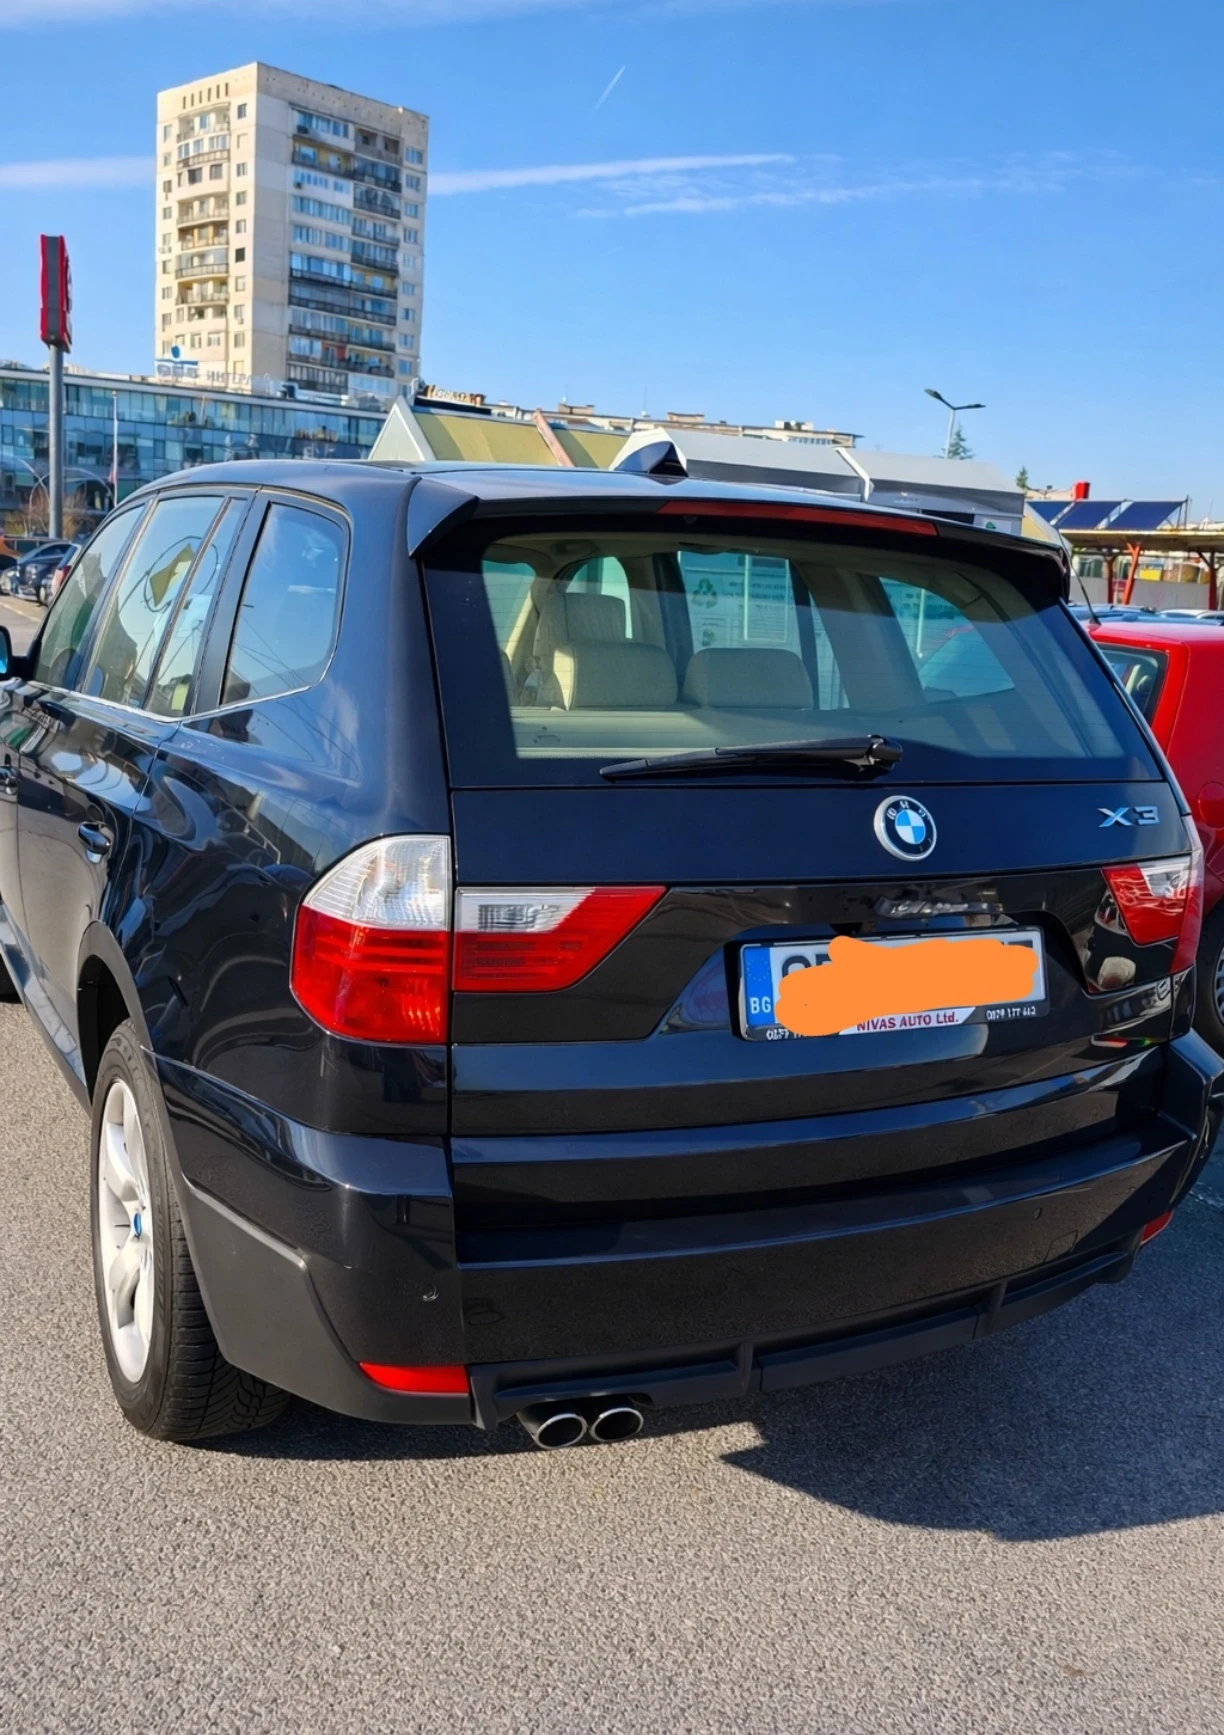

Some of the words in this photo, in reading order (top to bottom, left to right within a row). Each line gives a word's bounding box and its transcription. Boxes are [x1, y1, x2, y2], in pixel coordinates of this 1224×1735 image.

[1097, 806, 1160, 828] X3
[749, 996, 772, 1015] BG
[856, 1017, 896, 1032] NIVAS
[899, 1014, 932, 1028] AUTO
[936, 1011, 959, 1024] Ltd.
